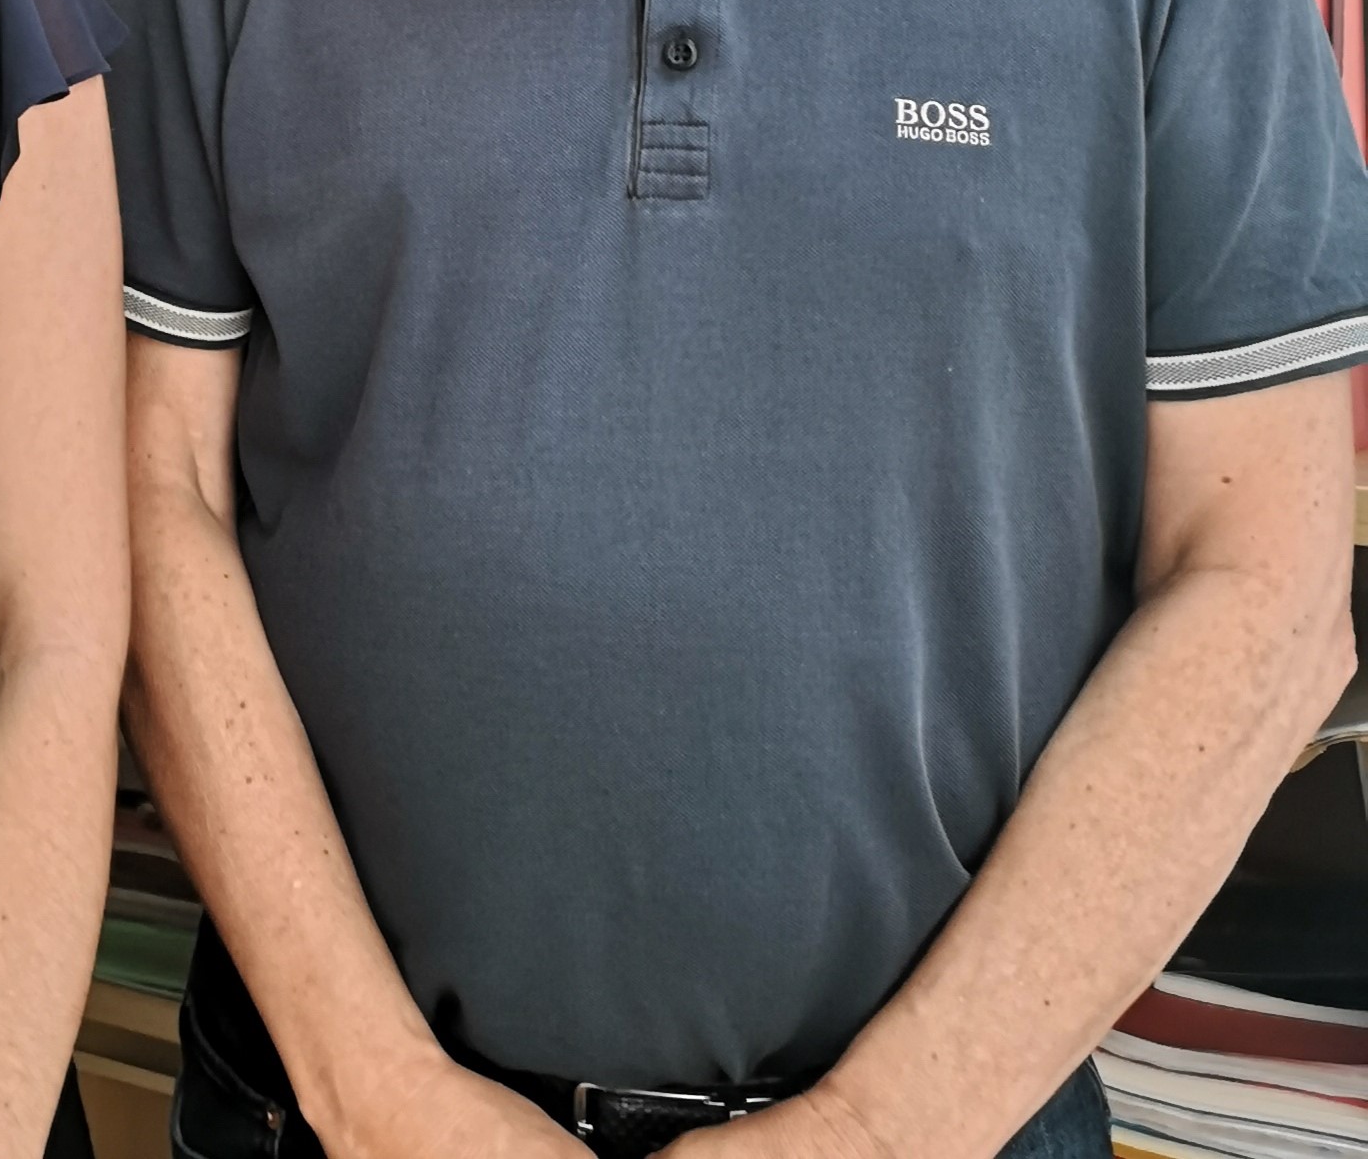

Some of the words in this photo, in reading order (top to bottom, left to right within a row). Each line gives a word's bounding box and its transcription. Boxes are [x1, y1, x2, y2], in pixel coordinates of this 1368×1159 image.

[894, 98, 990, 131] BOSS
[897, 125, 944, 142] HUGO
[945, 129, 991, 146] BOSS
